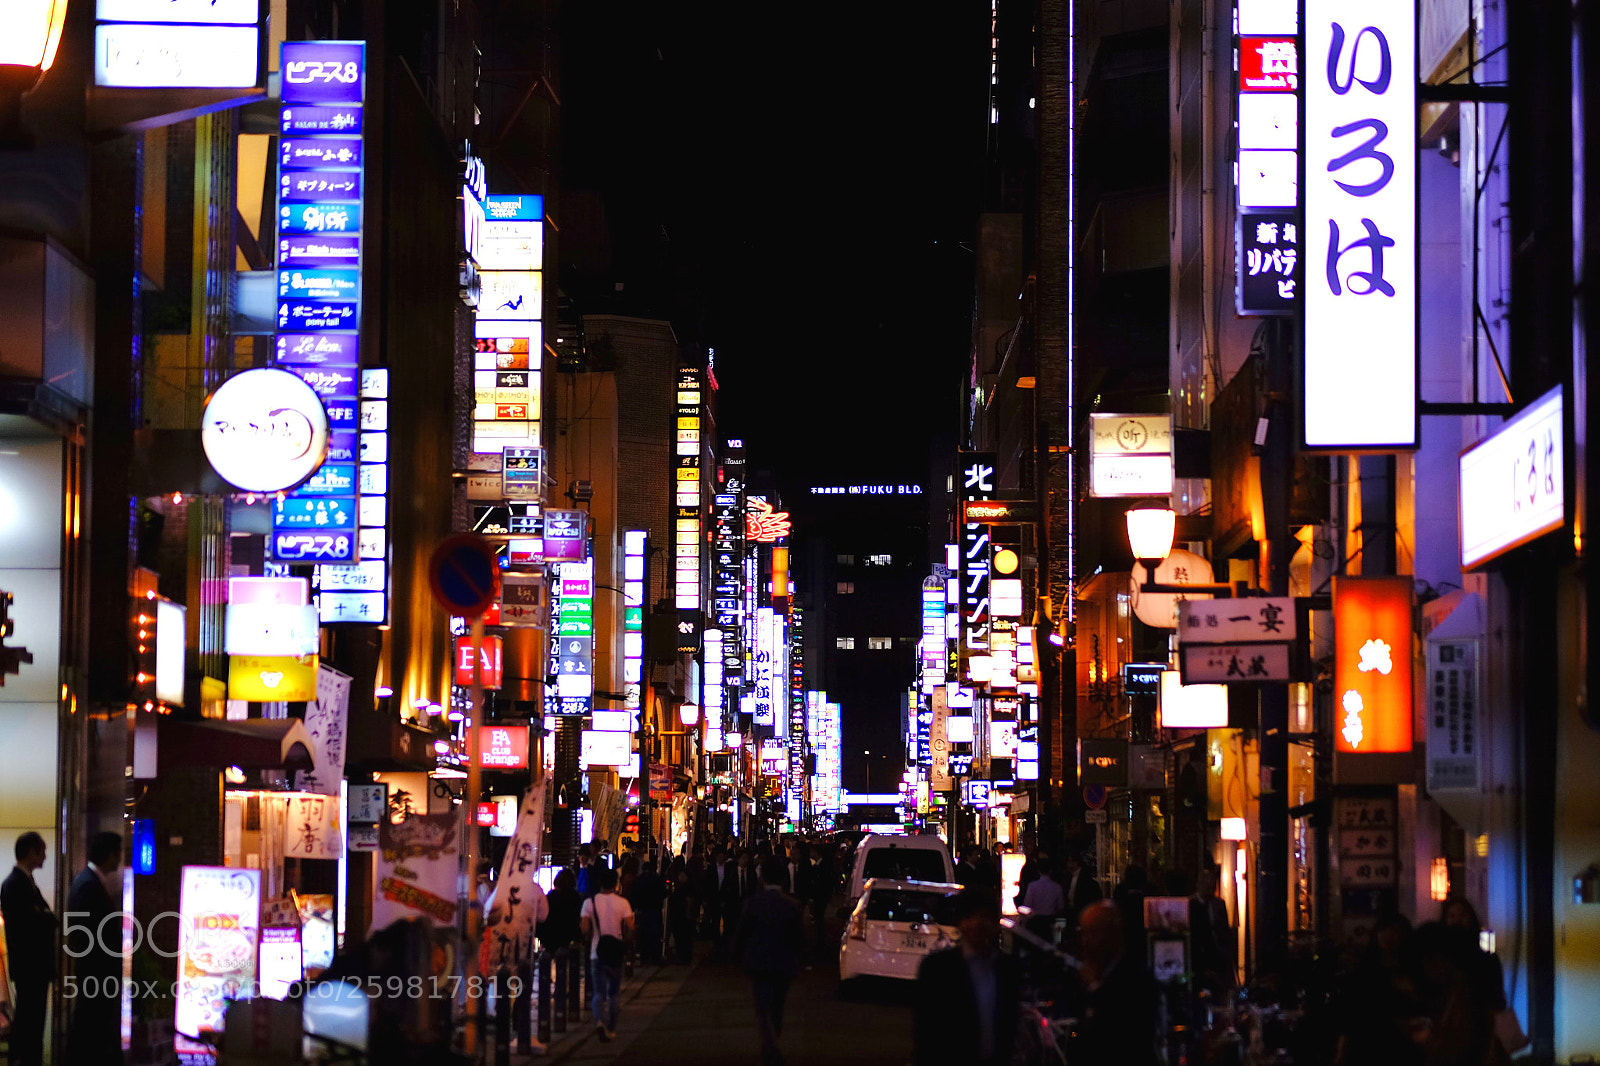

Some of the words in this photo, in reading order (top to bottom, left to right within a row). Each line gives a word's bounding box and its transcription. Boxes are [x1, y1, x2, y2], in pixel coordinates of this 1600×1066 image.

[1326, 22, 1395, 298] いろは
[897, 485, 922, 494] BLD.
[1227, 603, 1284, 633] 一宴
[482, 752, 520, 766] Brange
